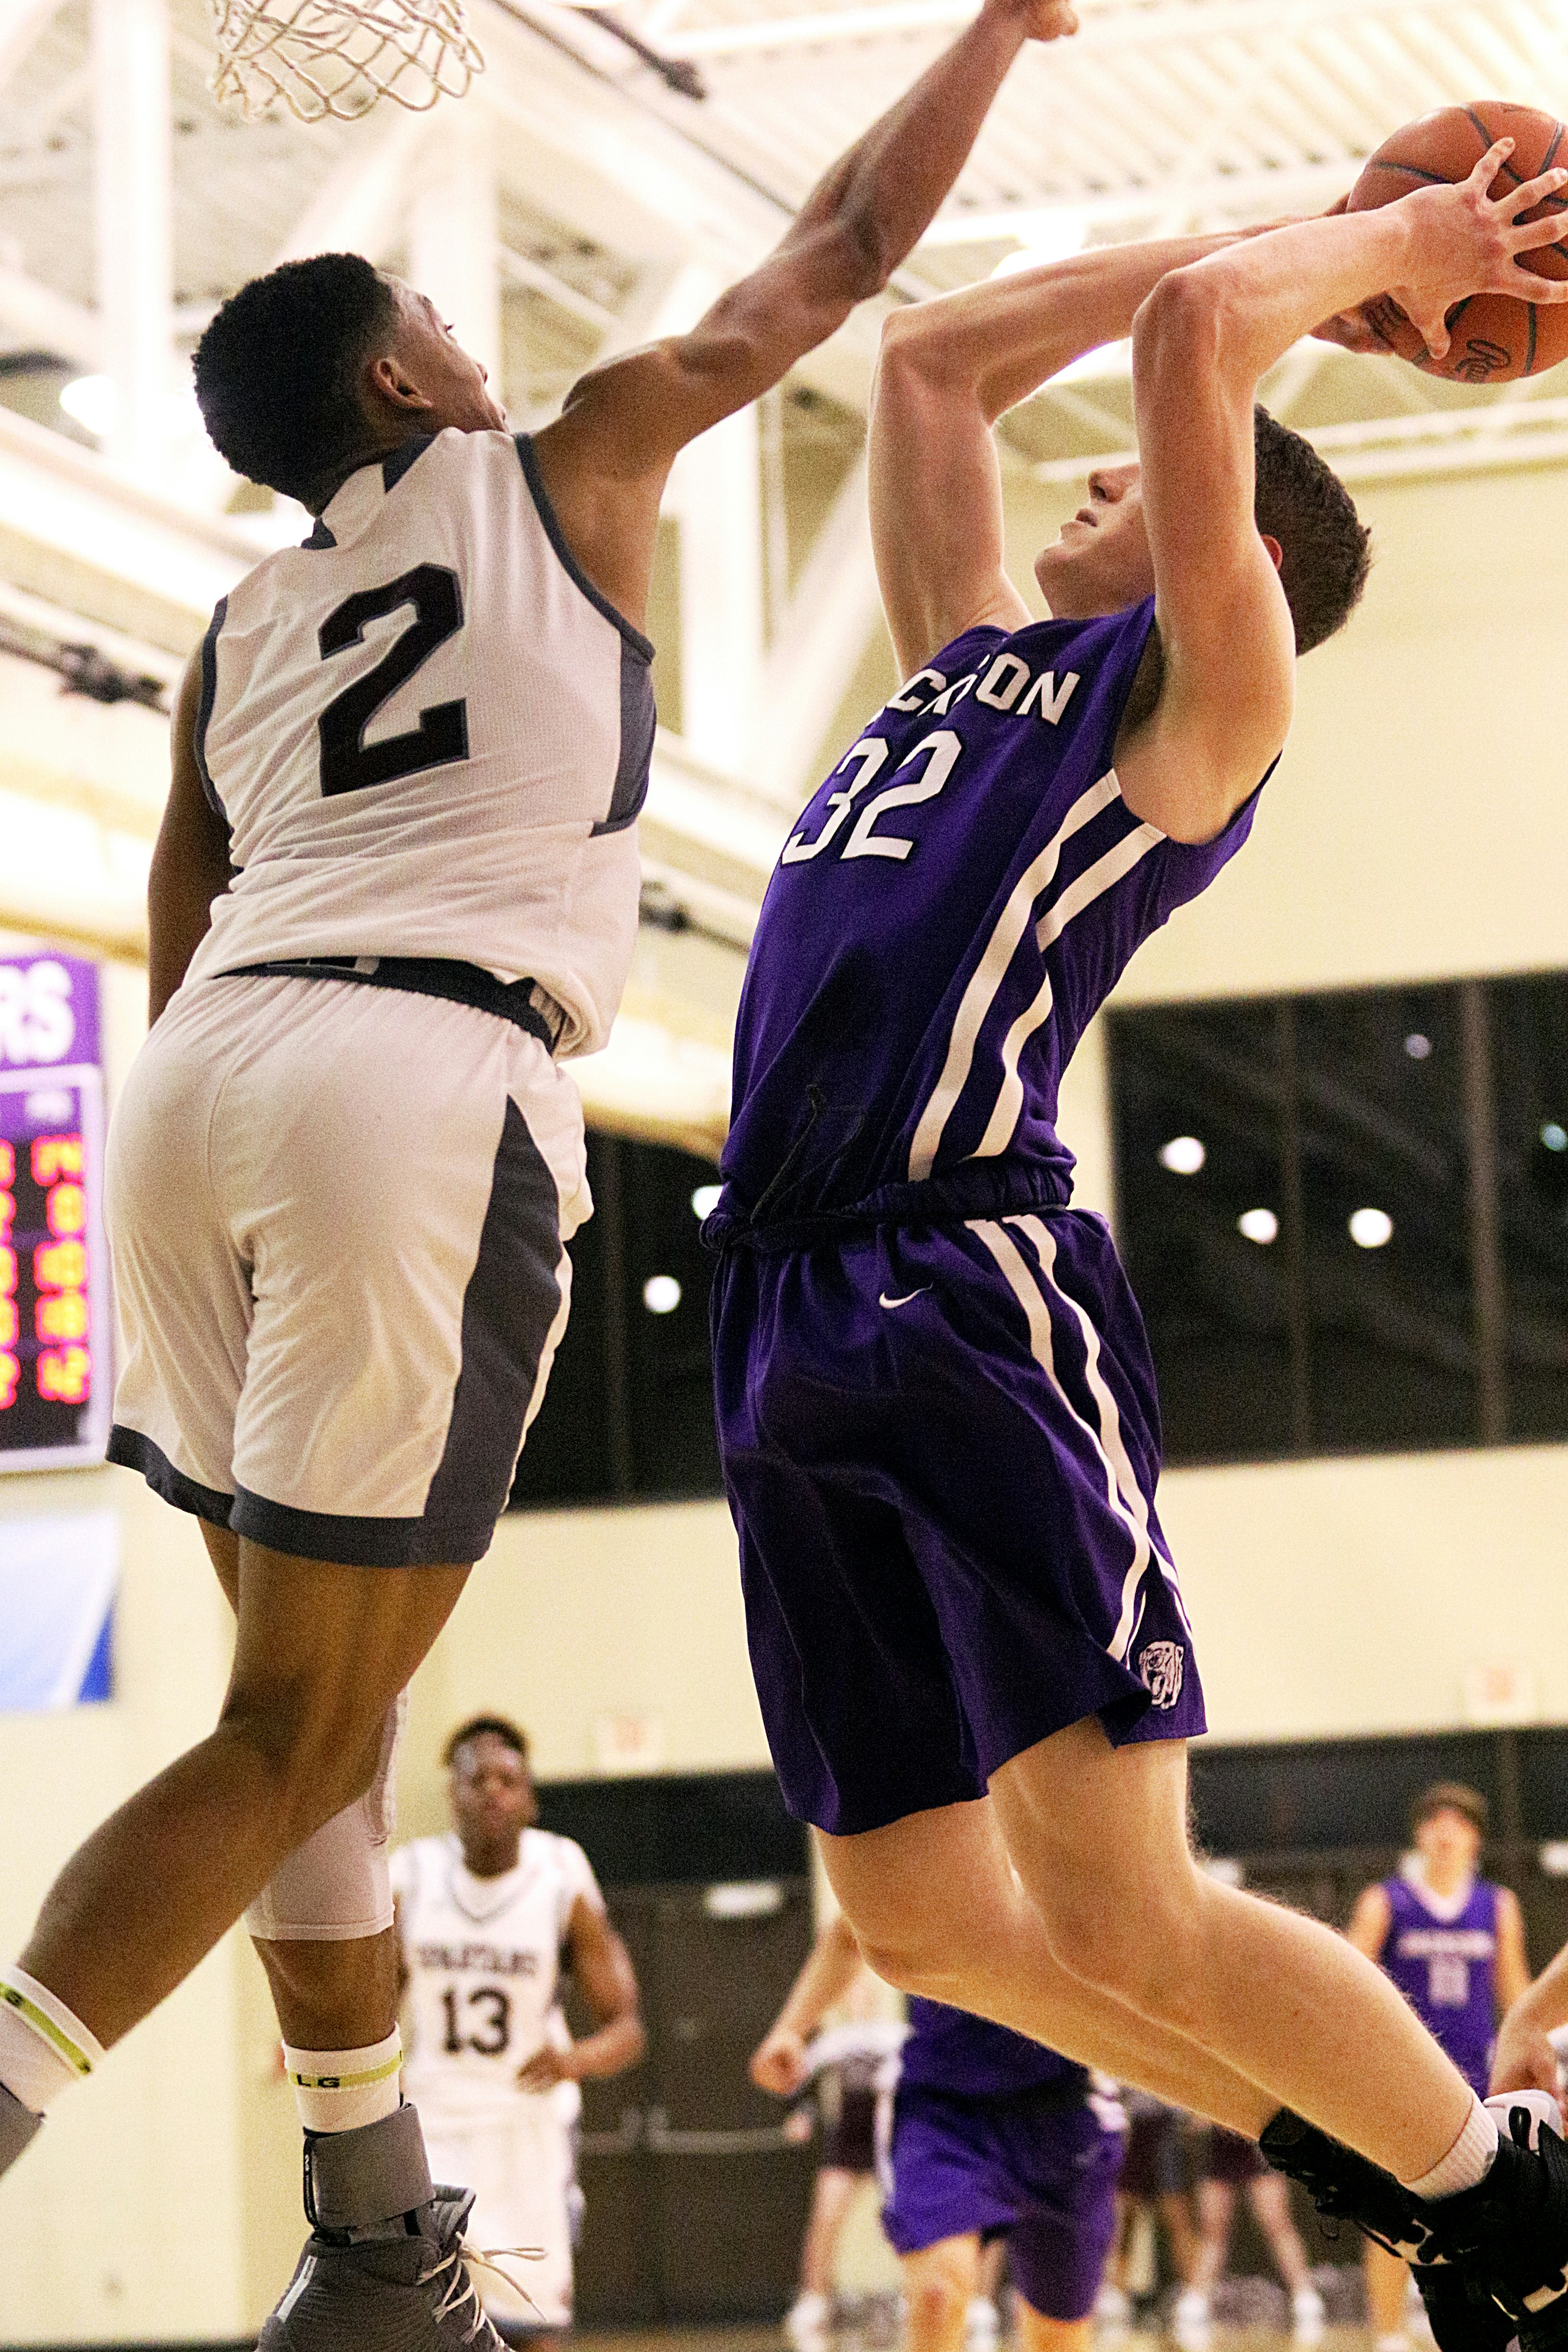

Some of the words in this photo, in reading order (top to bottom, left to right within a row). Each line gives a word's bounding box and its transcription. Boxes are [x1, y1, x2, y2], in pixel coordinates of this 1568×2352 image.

[318, 562, 470, 798] 2
[781, 730, 962, 865] 32
[443, 1985, 511, 2055] 13
